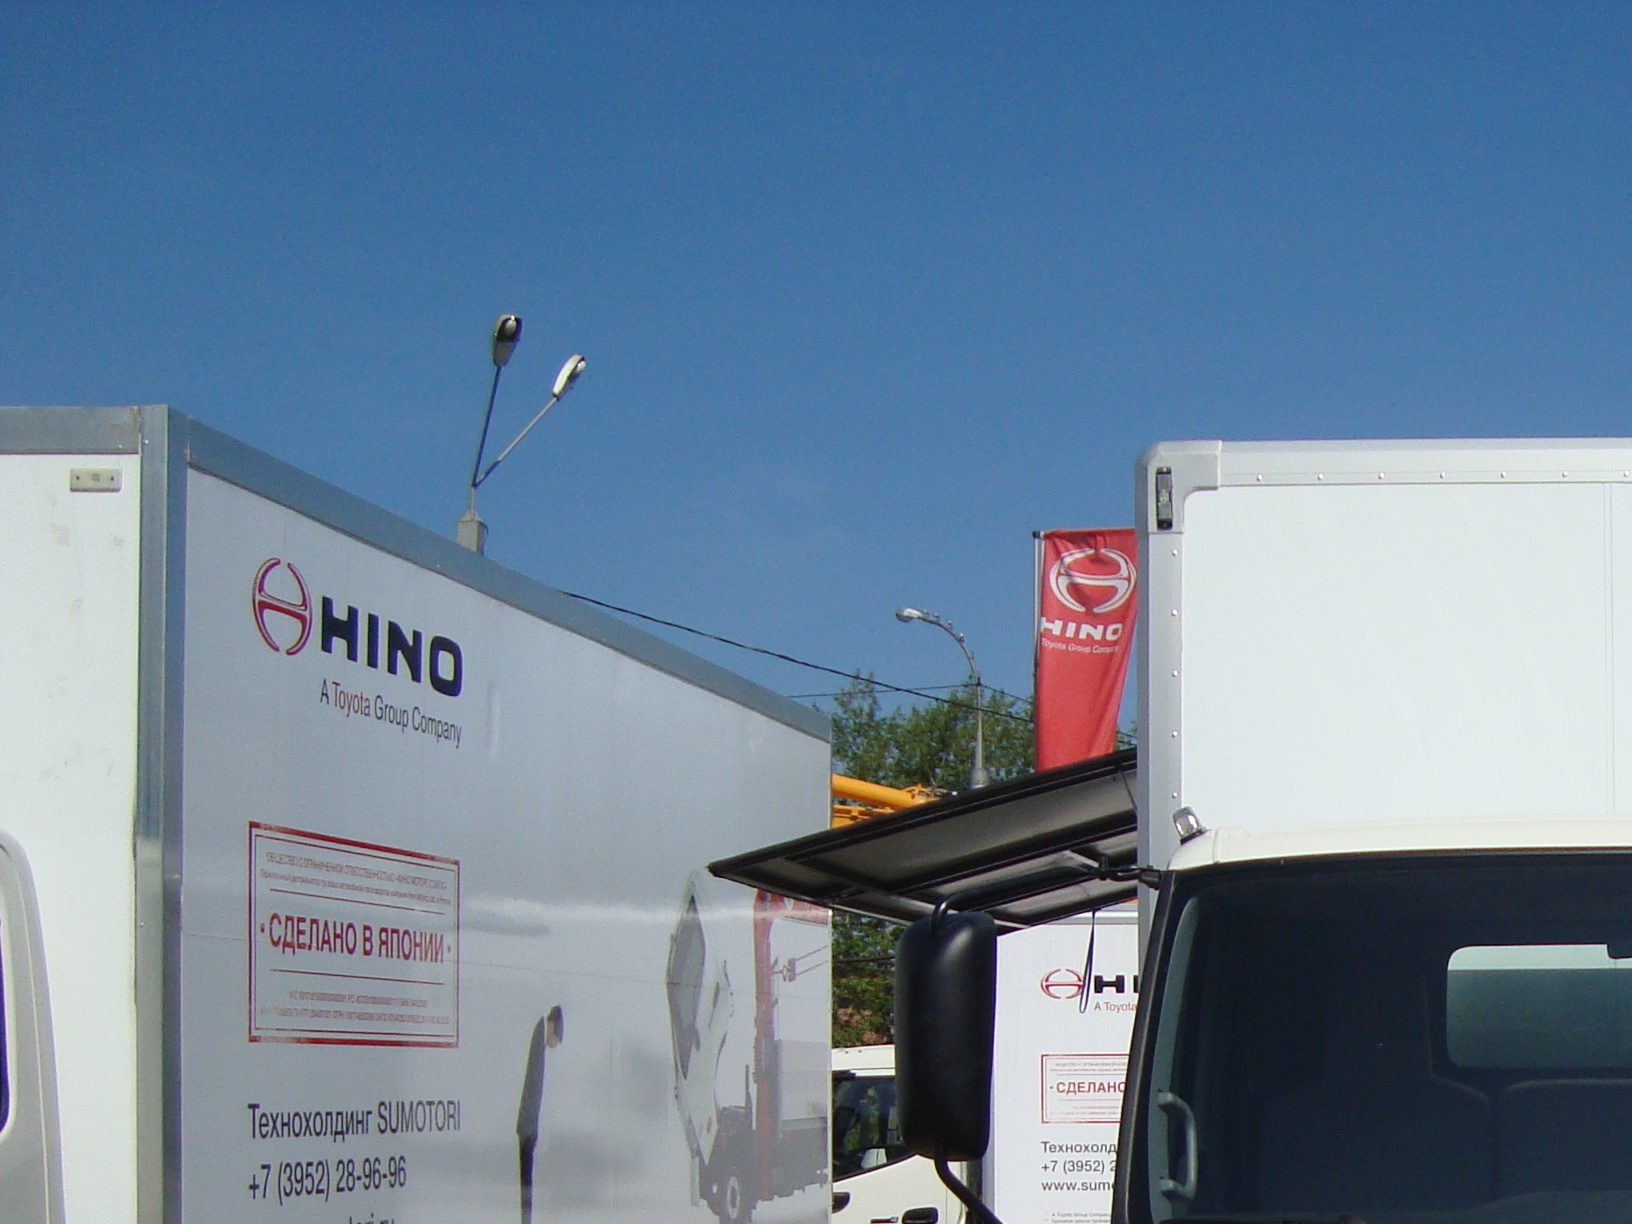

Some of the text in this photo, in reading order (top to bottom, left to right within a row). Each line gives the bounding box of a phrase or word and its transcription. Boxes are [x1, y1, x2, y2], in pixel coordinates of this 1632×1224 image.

[321, 596, 463, 697] HINO
[1041, 617, 1123, 641] HINO
[320, 678, 463, 749] A Toyota Group Company
[269, 913, 444, 964] СДЕЛАНО В ЯПОНИИ
[1094, 1002, 1102, 1011] A
[247, 1100, 461, 1143] Технохолдинг SUMOTORI
[249, 1155, 407, 1206] +7 (3952) 28-96-96
[1041, 1160, 1058, 1172] +7
[1063, 1160, 1105, 1175] (3952)
